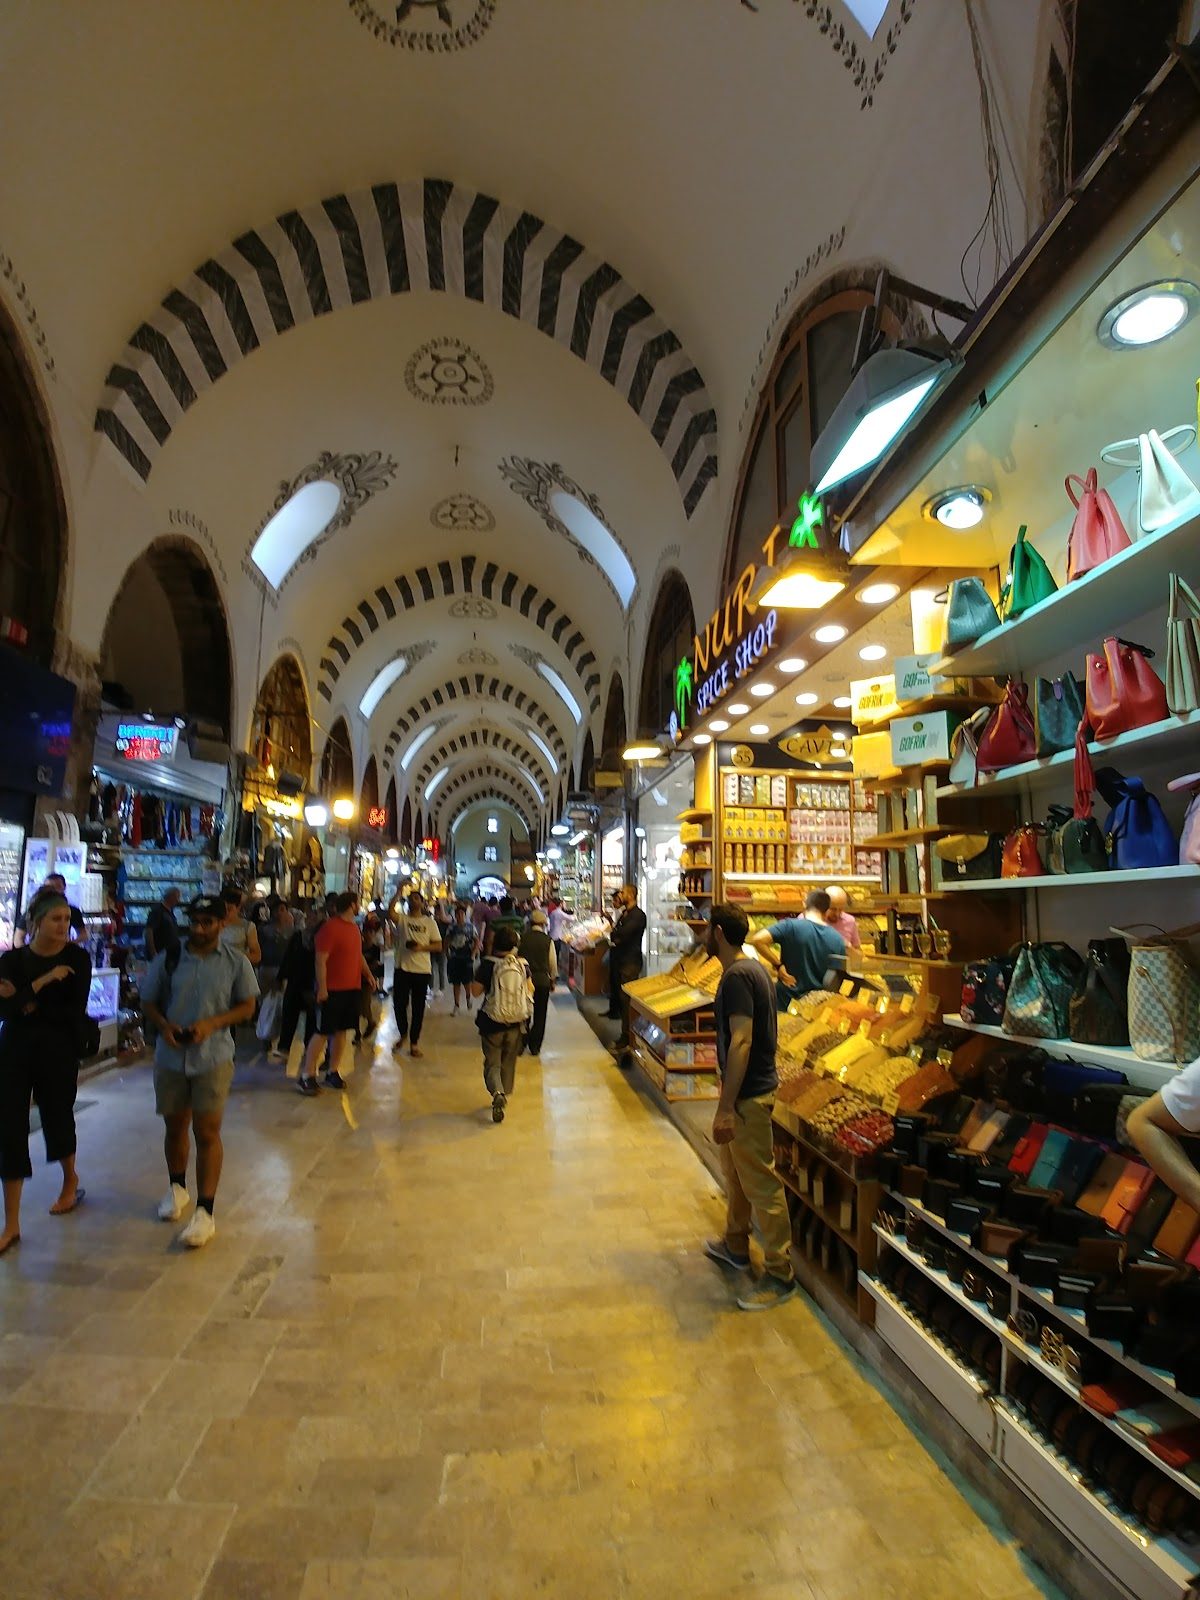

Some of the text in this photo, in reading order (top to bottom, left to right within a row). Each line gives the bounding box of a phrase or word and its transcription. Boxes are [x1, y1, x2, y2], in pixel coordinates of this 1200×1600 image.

[697, 609, 777, 716] SPICE SHOP
[786, 739, 853, 755] CAVIA
